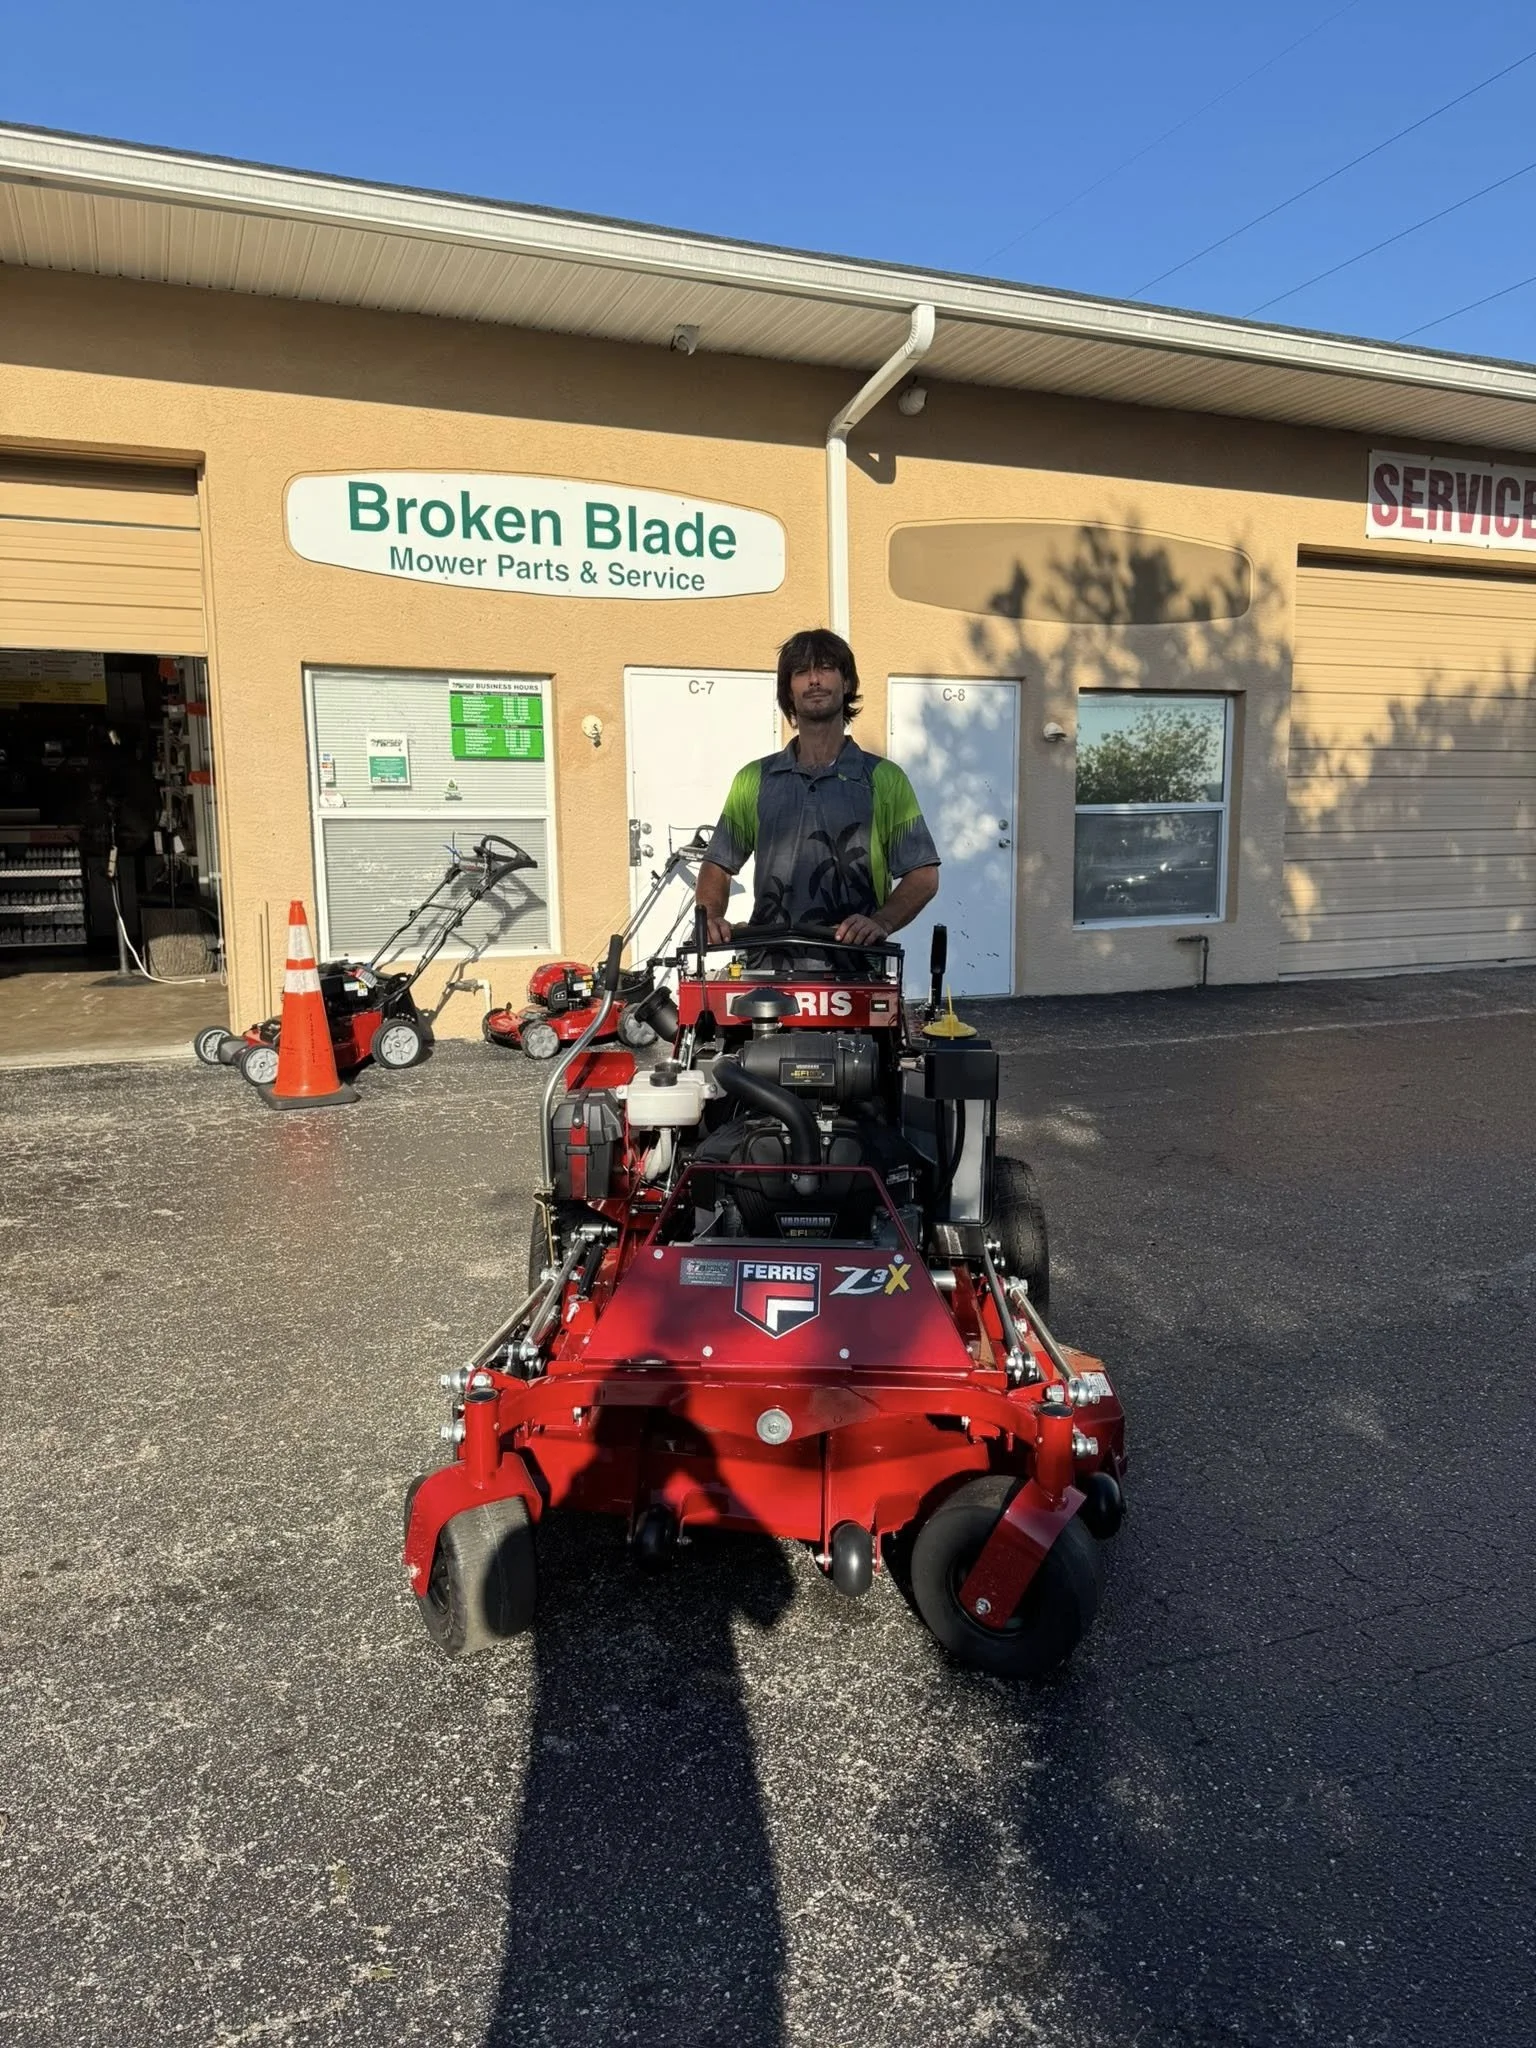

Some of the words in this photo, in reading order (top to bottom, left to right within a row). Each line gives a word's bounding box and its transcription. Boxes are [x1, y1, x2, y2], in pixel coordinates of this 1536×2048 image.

[348, 480, 563, 547] Broken
[585, 501, 737, 560] Blade
[389, 546, 487, 577] Mower
[497, 554, 570, 583] Parts
[580, 560, 599, 584] &
[608, 561, 706, 592] Service
[688, 680, 715, 695] C-7
[942, 687, 966, 702] C-8
[790, 1229, 807, 1237] EFI
[743, 1264, 816, 1281] FERRIS
[829, 1263, 912, 1296] Z3X
